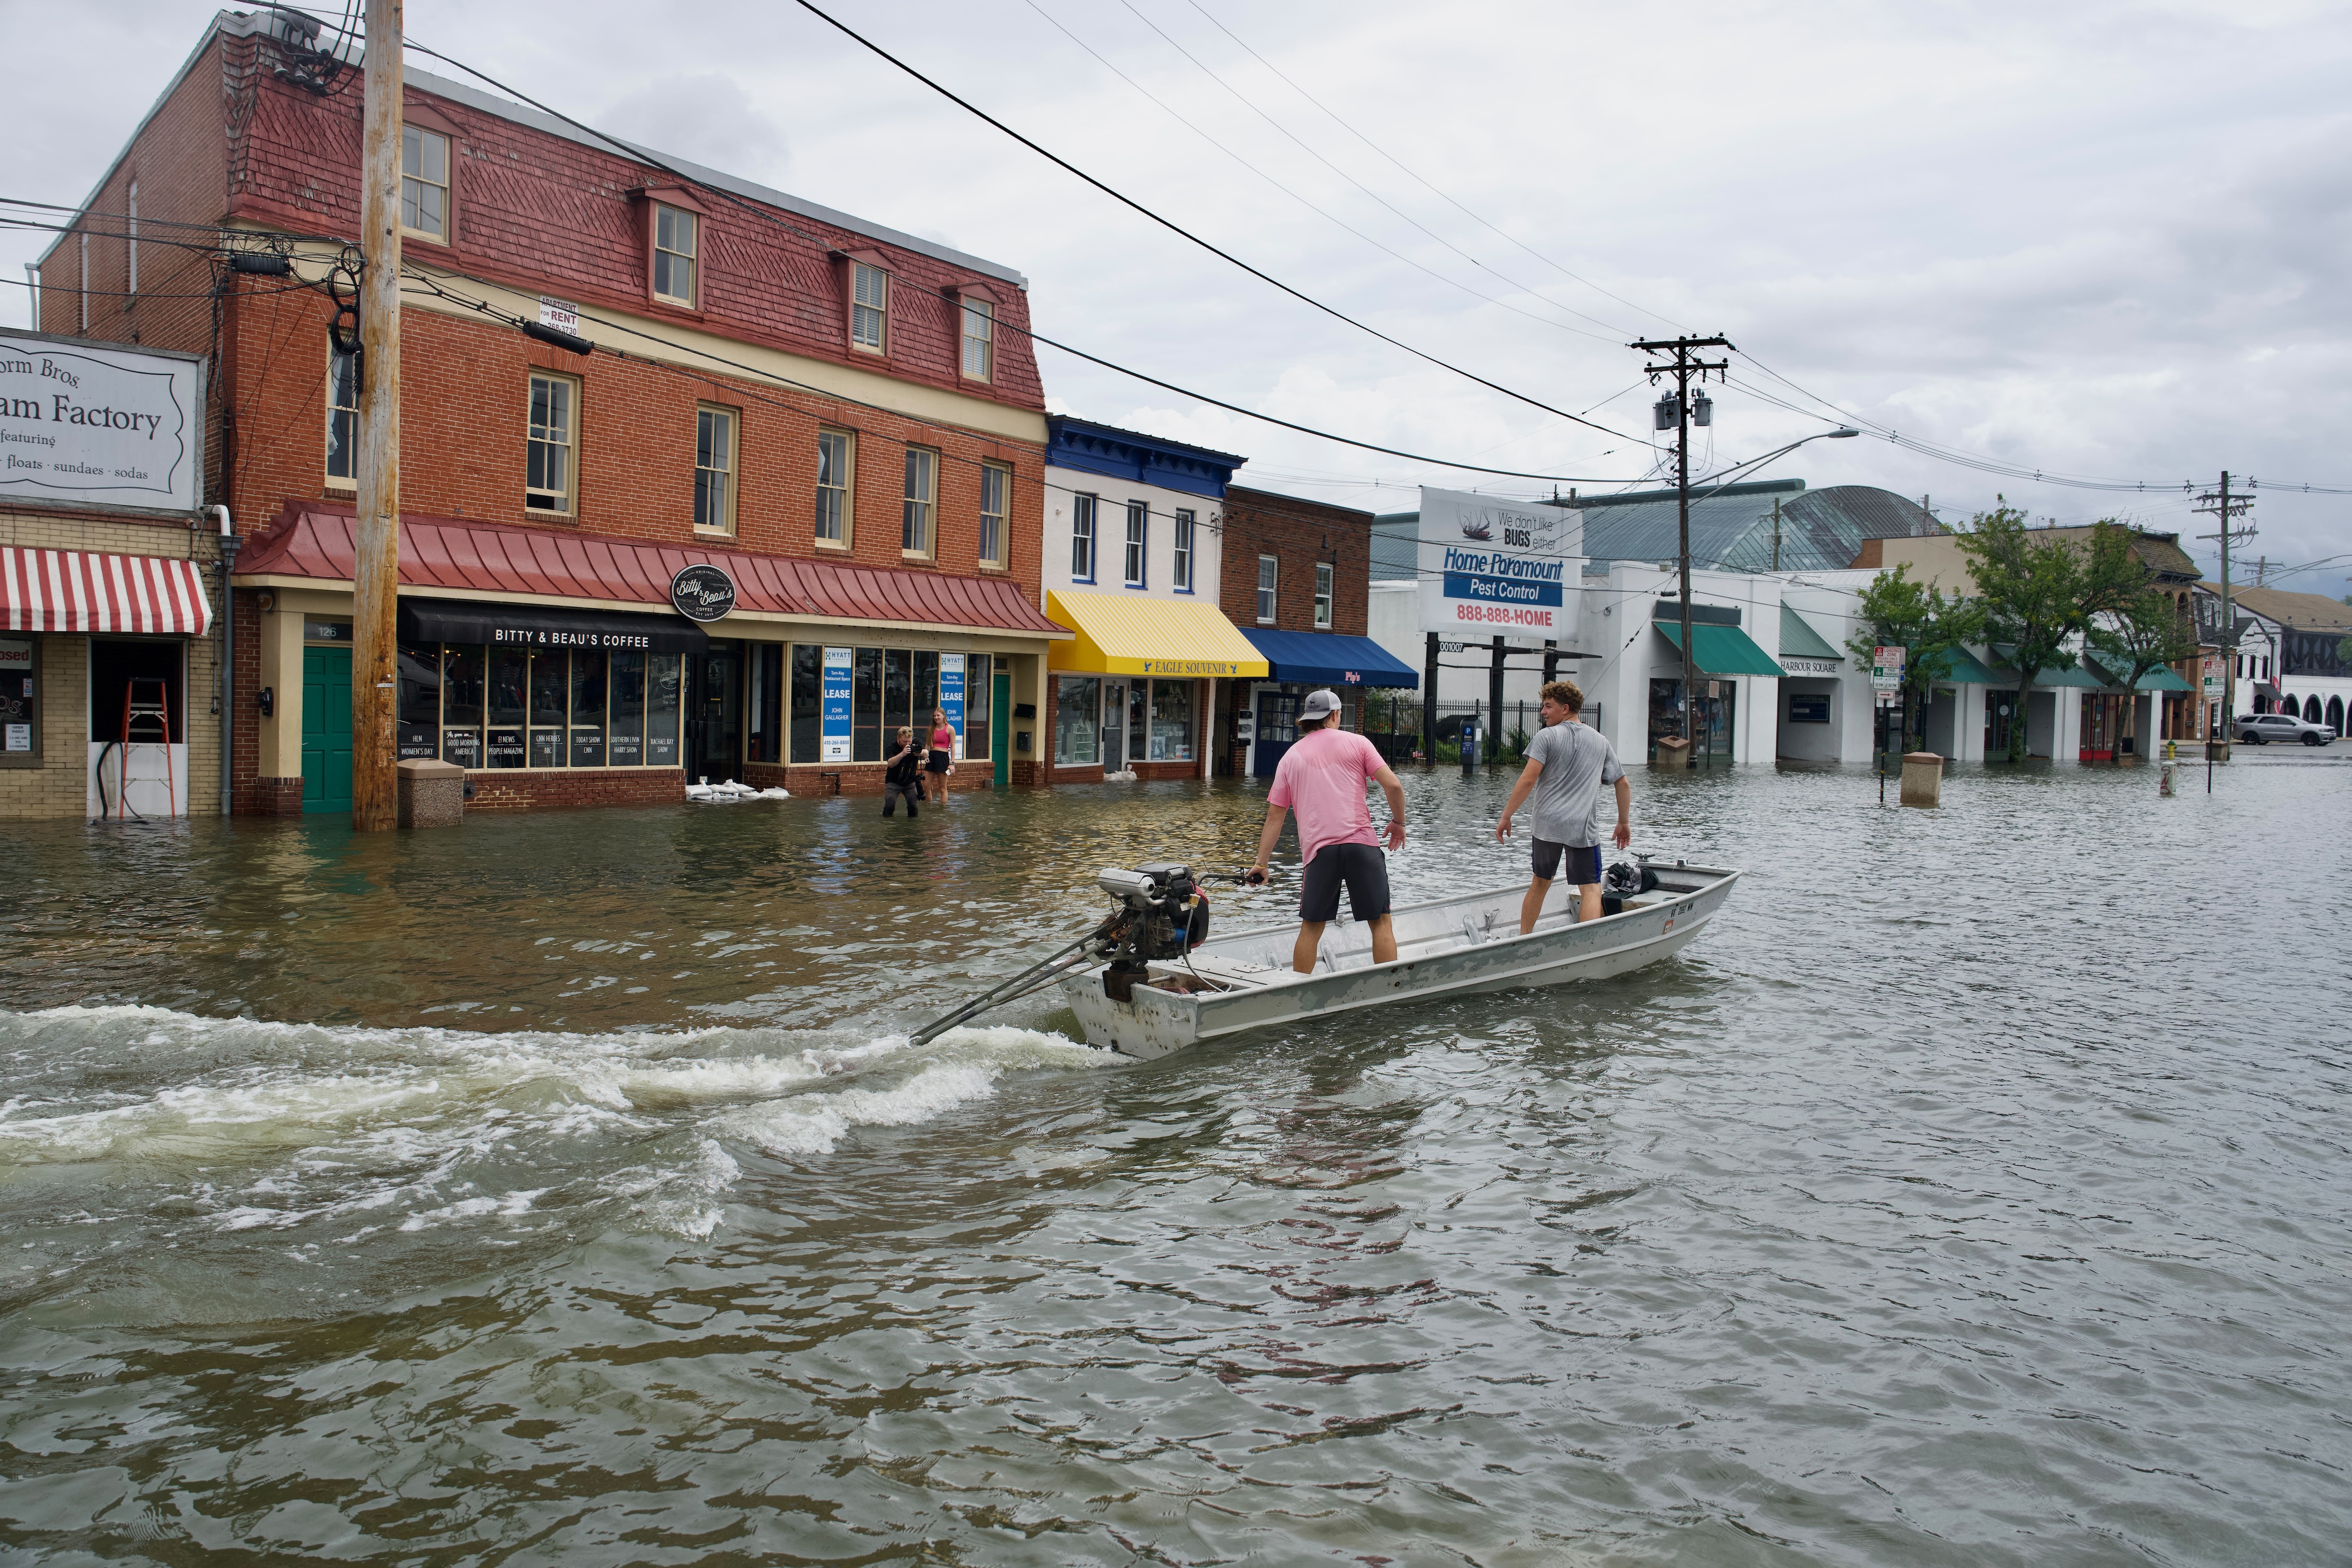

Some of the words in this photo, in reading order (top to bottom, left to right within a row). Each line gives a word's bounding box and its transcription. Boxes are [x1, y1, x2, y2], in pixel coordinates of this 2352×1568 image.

[541, 298, 576, 311] APARTMENT
[551, 310, 577, 325] RENT
[40, 358, 80, 389] Bros.
[52, 394, 161, 440] Factory
[0, 429, 56, 448] featuring
[7, 454, 42, 469] floats
[54, 462, 103, 475] sundaes
[115, 467, 148, 479] sodas
[1498, 511, 1512, 526] We
[1515, 515, 1537, 530] don't
[1539, 517, 1553, 532] like
[1504, 528, 1530, 548] BUGS
[1533, 536, 1556, 550] either
[1444, 547, 1487, 573] Home
[1490, 553, 1563, 581] Paramount
[676, 579, 702, 596] Bitty
[700, 587, 733, 605] Beau's
[1470, 579, 1496, 597] Pest
[1499, 582, 1539, 600] Control
[1457, 604, 1552, 627] 888-888-HOME
[318, 627, 337, 637] 126
[495, 629, 533, 642] BITTY
[539, 632, 546, 643] &
[552, 632, 598, 645] BEAU'S
[603, 635, 649, 647] COFFEE
[1440, 642, 1463, 652] 001007
[1155, 661, 1183, 673] EAGLE
[1185, 662, 1226, 674] SOUVENIR
[1780, 661, 1811, 672] HARBOUR
[1812, 662, 1836, 673] SQUARE
[1345, 671, 1360, 684] Pip's
[825, 689, 850, 698] LEASE
[941, 692, 963, 701] LEASE
